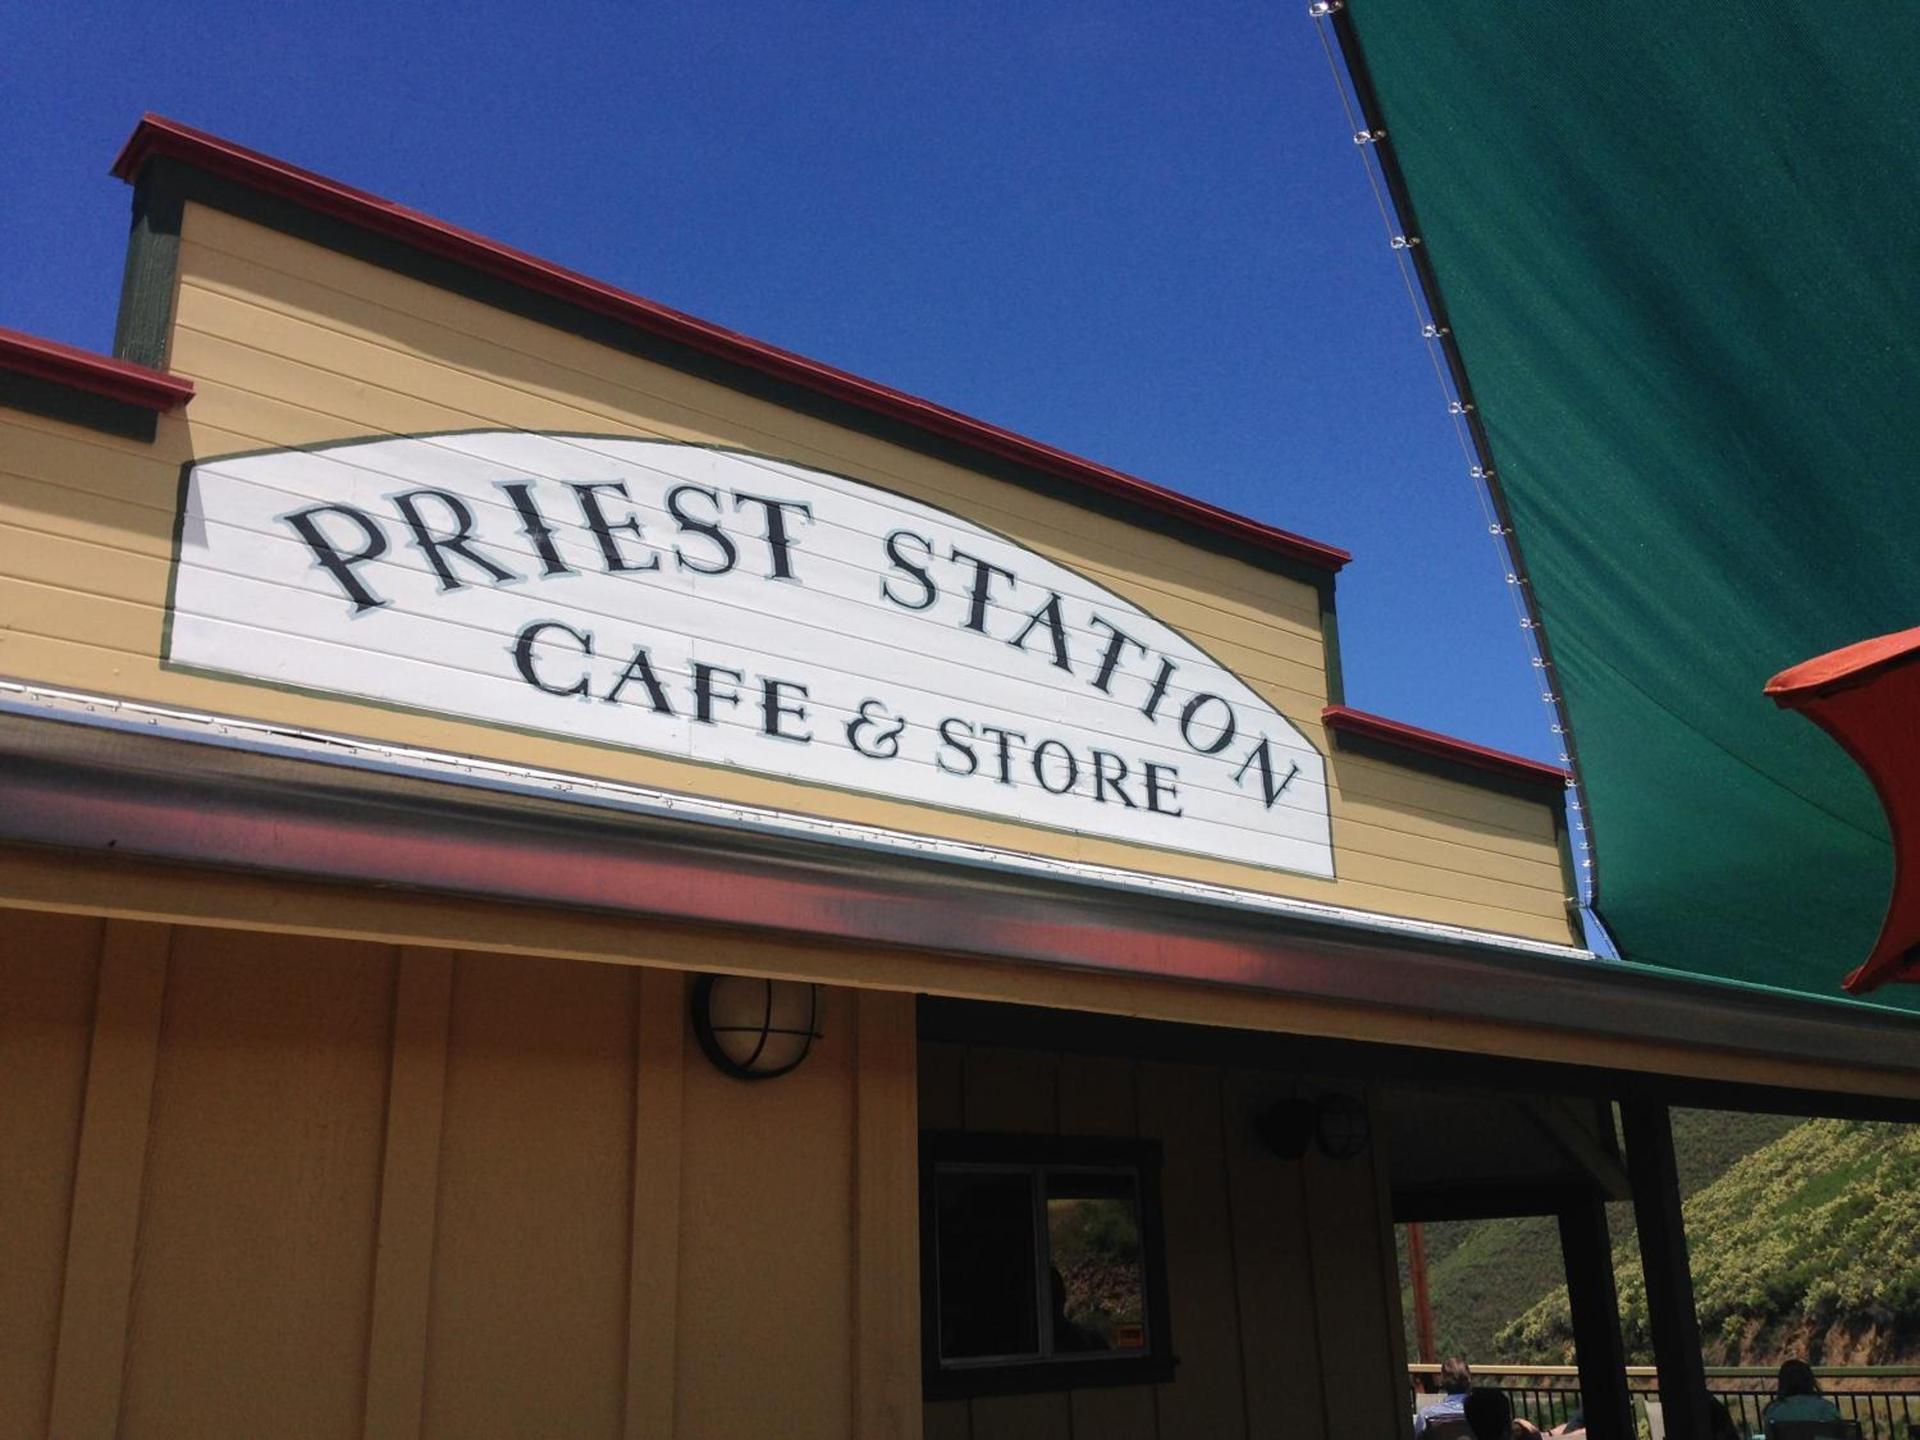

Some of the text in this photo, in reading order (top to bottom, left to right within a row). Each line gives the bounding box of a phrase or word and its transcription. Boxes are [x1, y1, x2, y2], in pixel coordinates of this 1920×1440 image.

[279, 478, 1300, 810] PRIEST STATION
[508, 620, 1183, 818] CAFE & STORE
